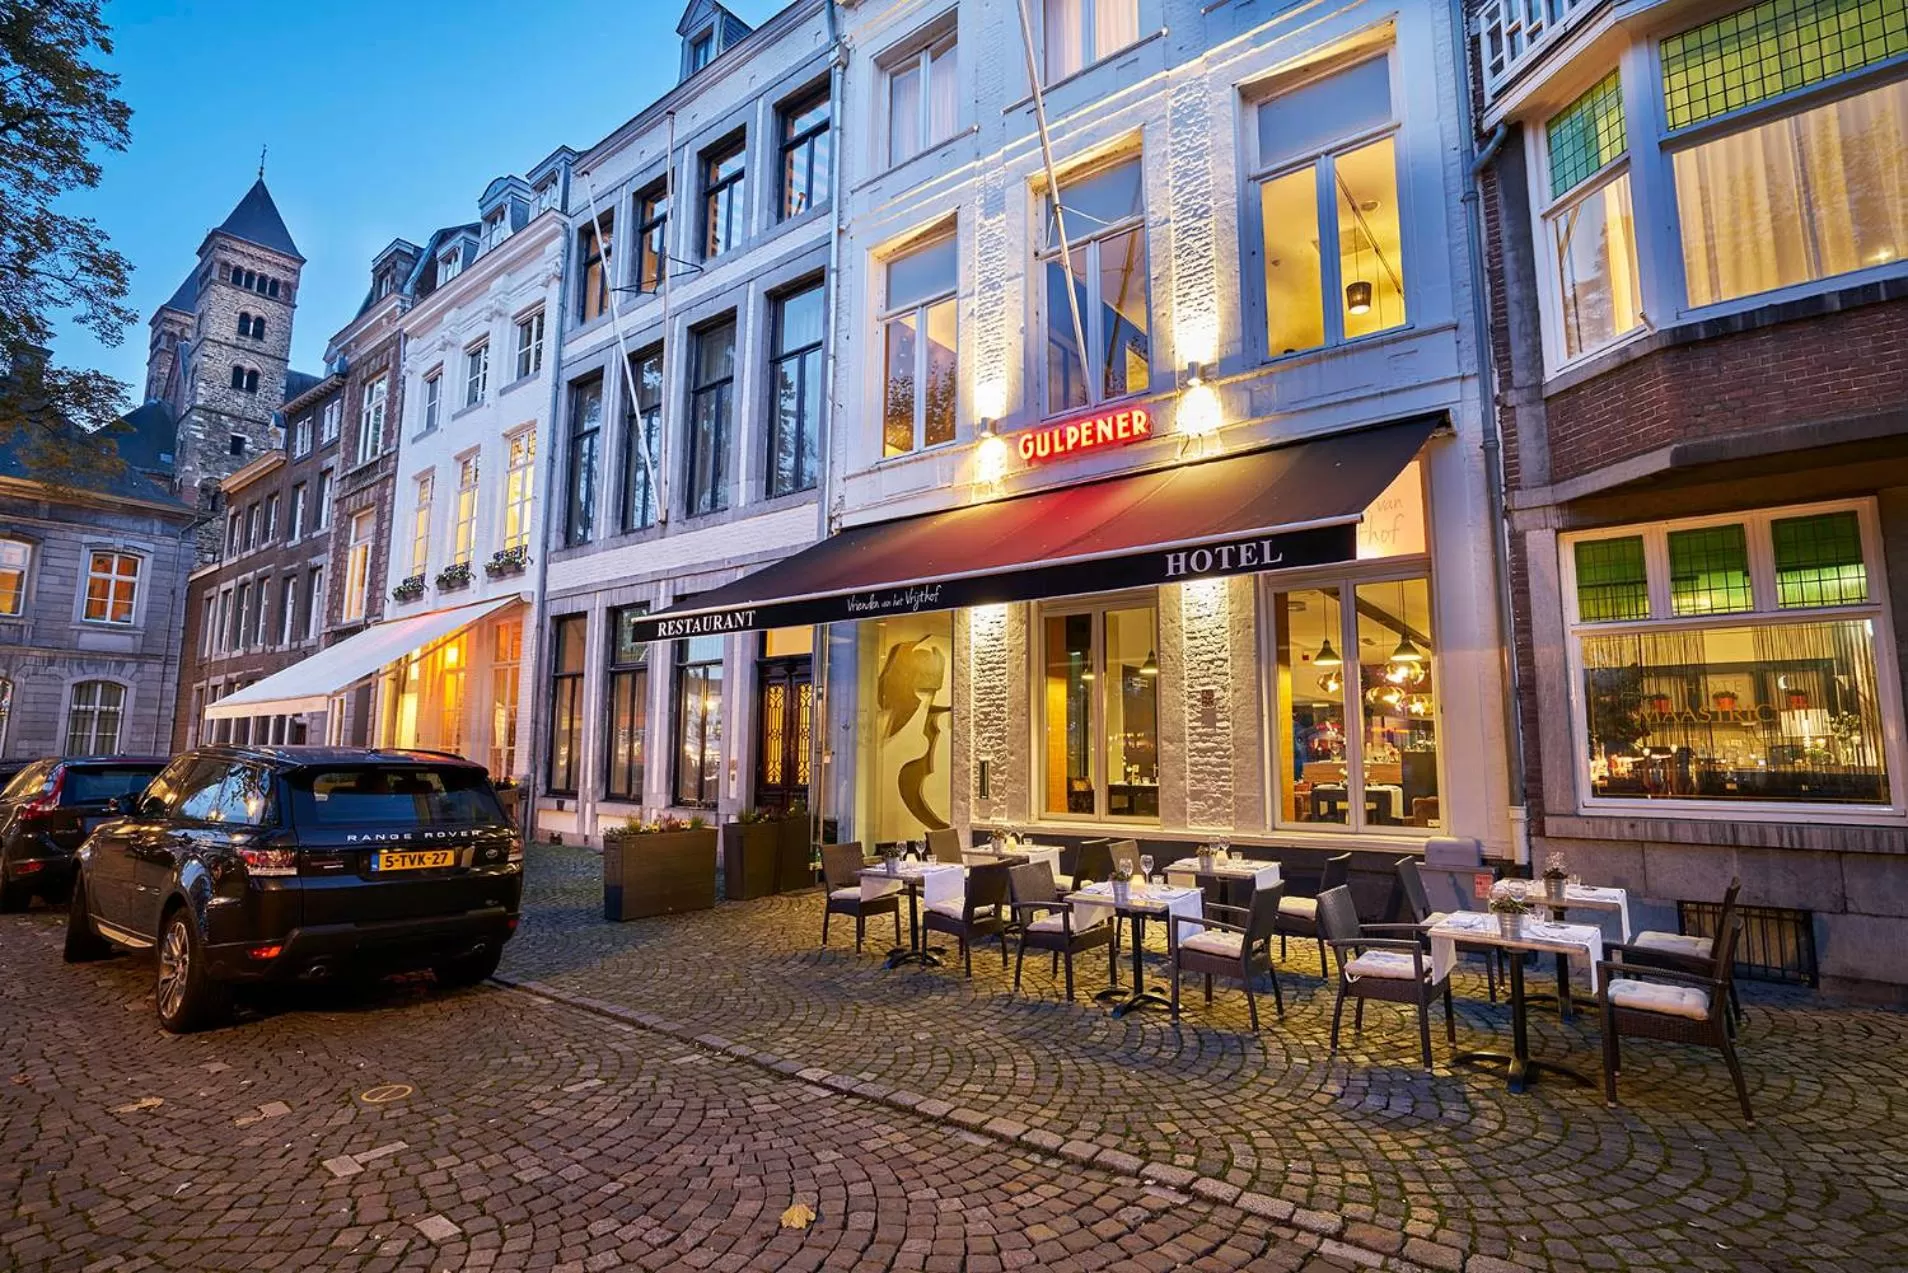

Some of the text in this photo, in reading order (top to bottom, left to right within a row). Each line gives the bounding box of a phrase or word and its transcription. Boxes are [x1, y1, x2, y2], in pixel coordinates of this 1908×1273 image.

[1018, 409, 1148, 461] GULPENER
[1165, 540, 1283, 577] HOTEL
[657, 610, 756, 637] RESTAURANT
[347, 830, 481, 841] RANGE ROVER
[385, 852, 449, 868] 5-TVK-27
